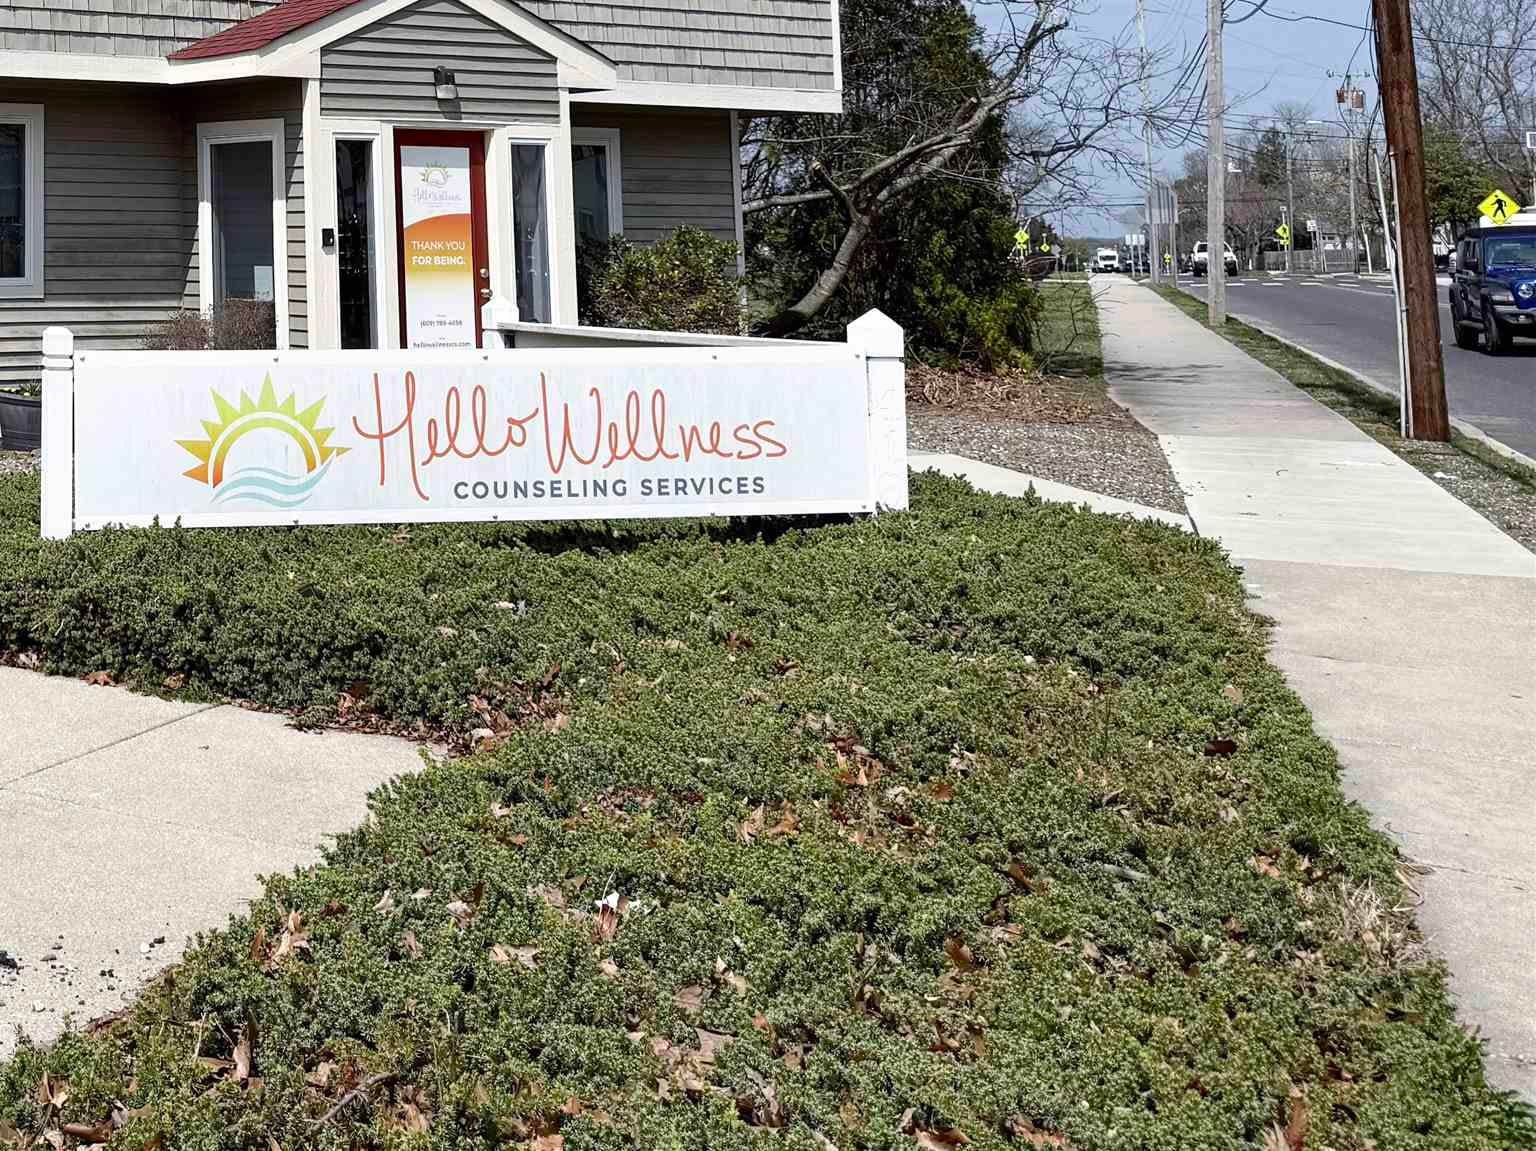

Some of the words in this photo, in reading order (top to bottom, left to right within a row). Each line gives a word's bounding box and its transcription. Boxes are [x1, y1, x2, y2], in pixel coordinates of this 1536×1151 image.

[411, 240, 444, 250] THANK
[445, 240, 465, 250] YOU
[412, 256, 432, 265] FOR
[352, 370, 539, 501] Hello
[540, 371, 787, 474] Wellness
[453, 479, 628, 500] COUNSELING
[640, 476, 766, 497] SERVICES
